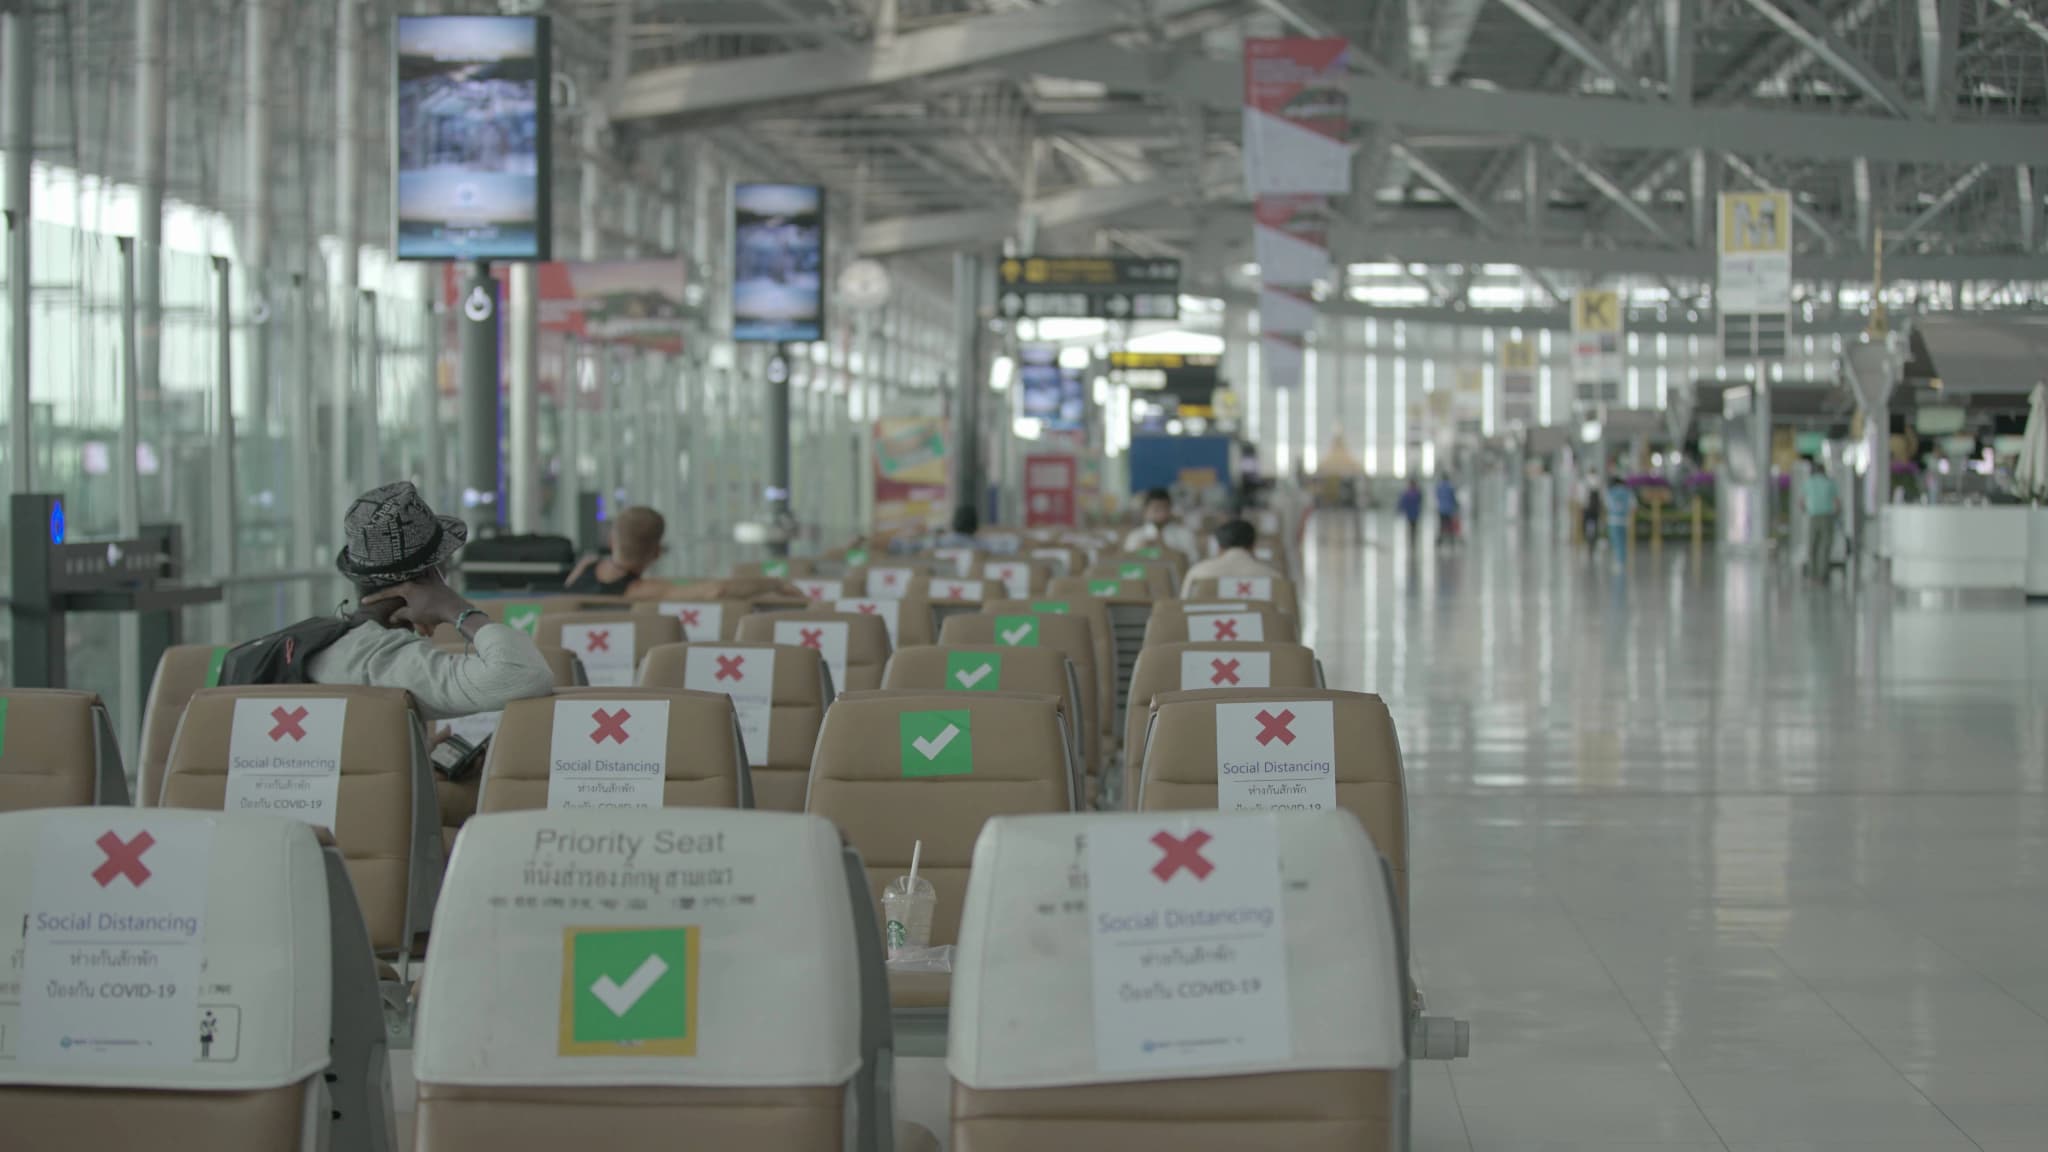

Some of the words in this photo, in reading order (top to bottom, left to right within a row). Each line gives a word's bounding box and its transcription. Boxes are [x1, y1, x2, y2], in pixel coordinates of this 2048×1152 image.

[1732, 201, 1778, 248] M
[1583, 296, 1612, 327] K
[233, 756, 269, 770] Social
[272, 756, 336, 773] Distancing
[555, 759, 591, 772] Social
[595, 759, 660, 775] Distancing
[1223, 761, 1260, 775] Social
[1264, 759, 1330, 774] Distancing
[273, 799, 323, 810] COVID-19
[534, 828, 643, 860] Priority
[653, 828, 726, 855] Seat
[37, 912, 92, 932] Social
[98, 912, 198, 936] Distancing
[1098, 911, 1160, 935] Social
[1164, 905, 1275, 932] Distancing
[99, 982, 177, 999] COVID-19
[1176, 977, 1262, 1000] COVID-19
